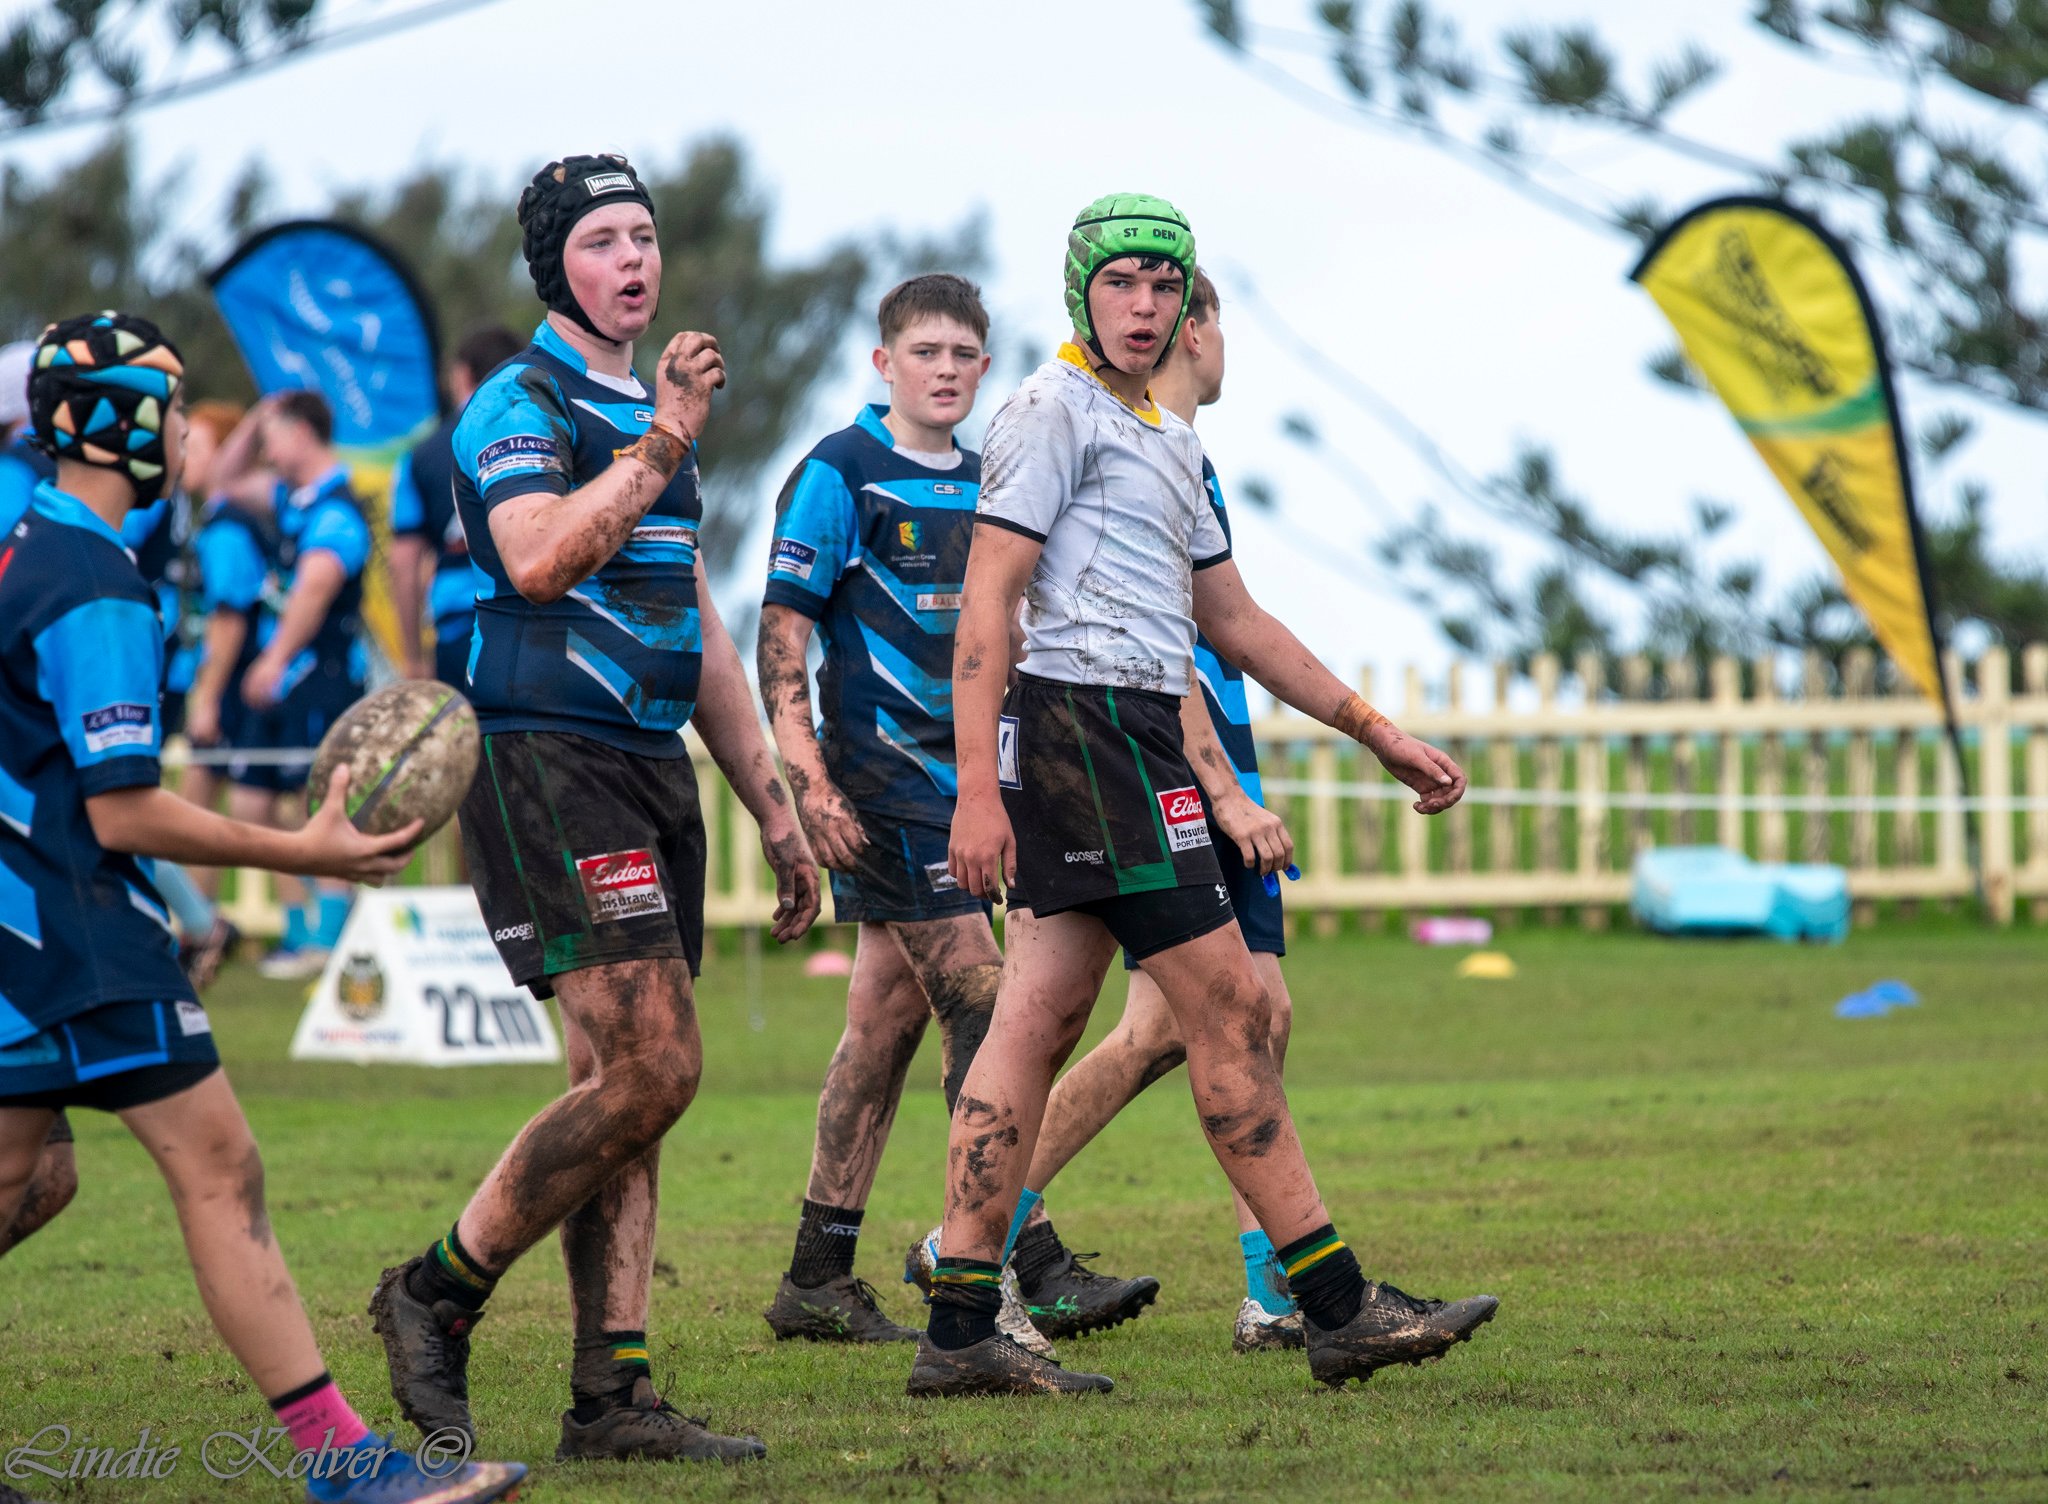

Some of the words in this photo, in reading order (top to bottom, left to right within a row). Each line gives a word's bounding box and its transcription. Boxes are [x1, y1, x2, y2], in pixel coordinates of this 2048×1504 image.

[589, 175, 630, 192] MADISON
[1123, 227, 1138, 238] ST
[1153, 228, 1176, 241] DEN
[1176, 840, 1195, 849] PORT
[1064, 849, 1104, 863] GOOSEY
[591, 860, 651, 886] Elders
[495, 922, 534, 942] GOOSEY
[424, 986, 541, 1047] 22m
